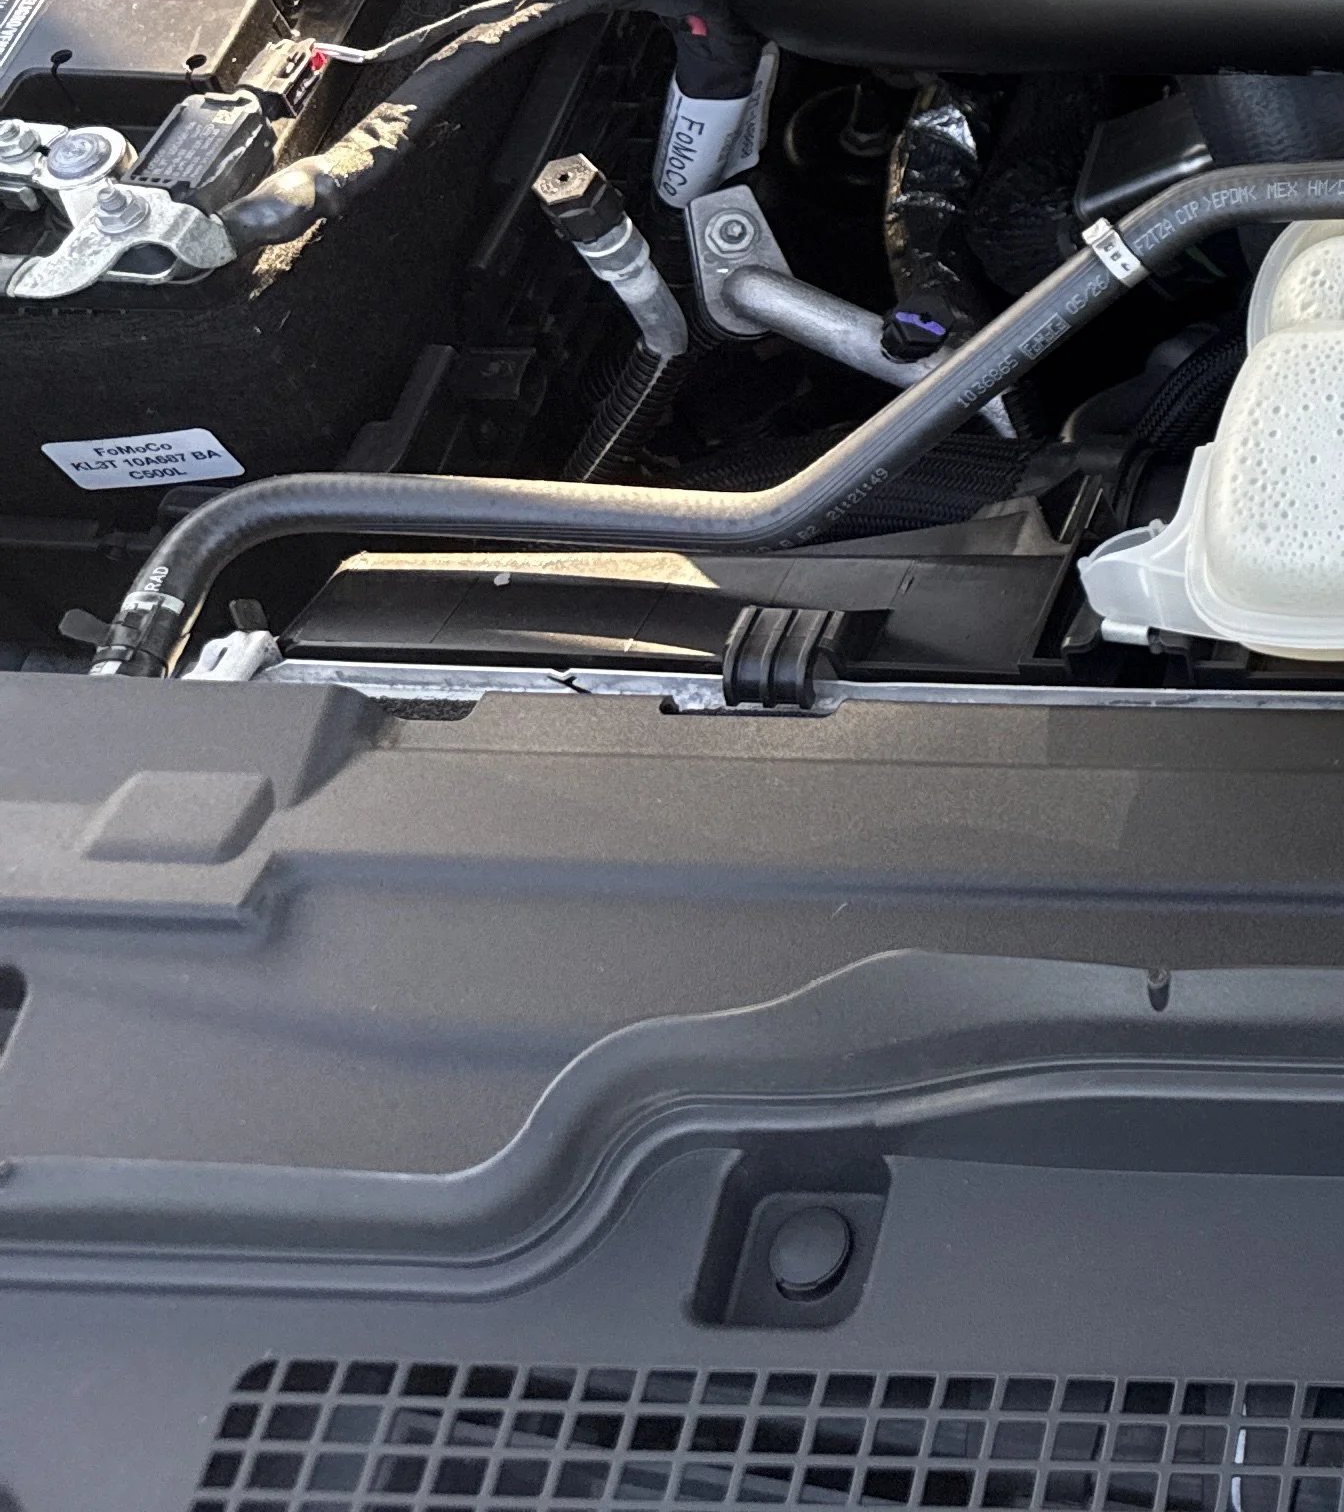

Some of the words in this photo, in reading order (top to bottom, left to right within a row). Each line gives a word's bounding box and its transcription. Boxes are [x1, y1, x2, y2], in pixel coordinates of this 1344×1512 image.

[663, 115, 705, 197] FoMoCo
[1267, 181, 1299, 201] MEX
[93, 442, 173, 457] FoMoCo
[70, 459, 117, 472] KL3T
[144, 566, 169, 592] RAD
